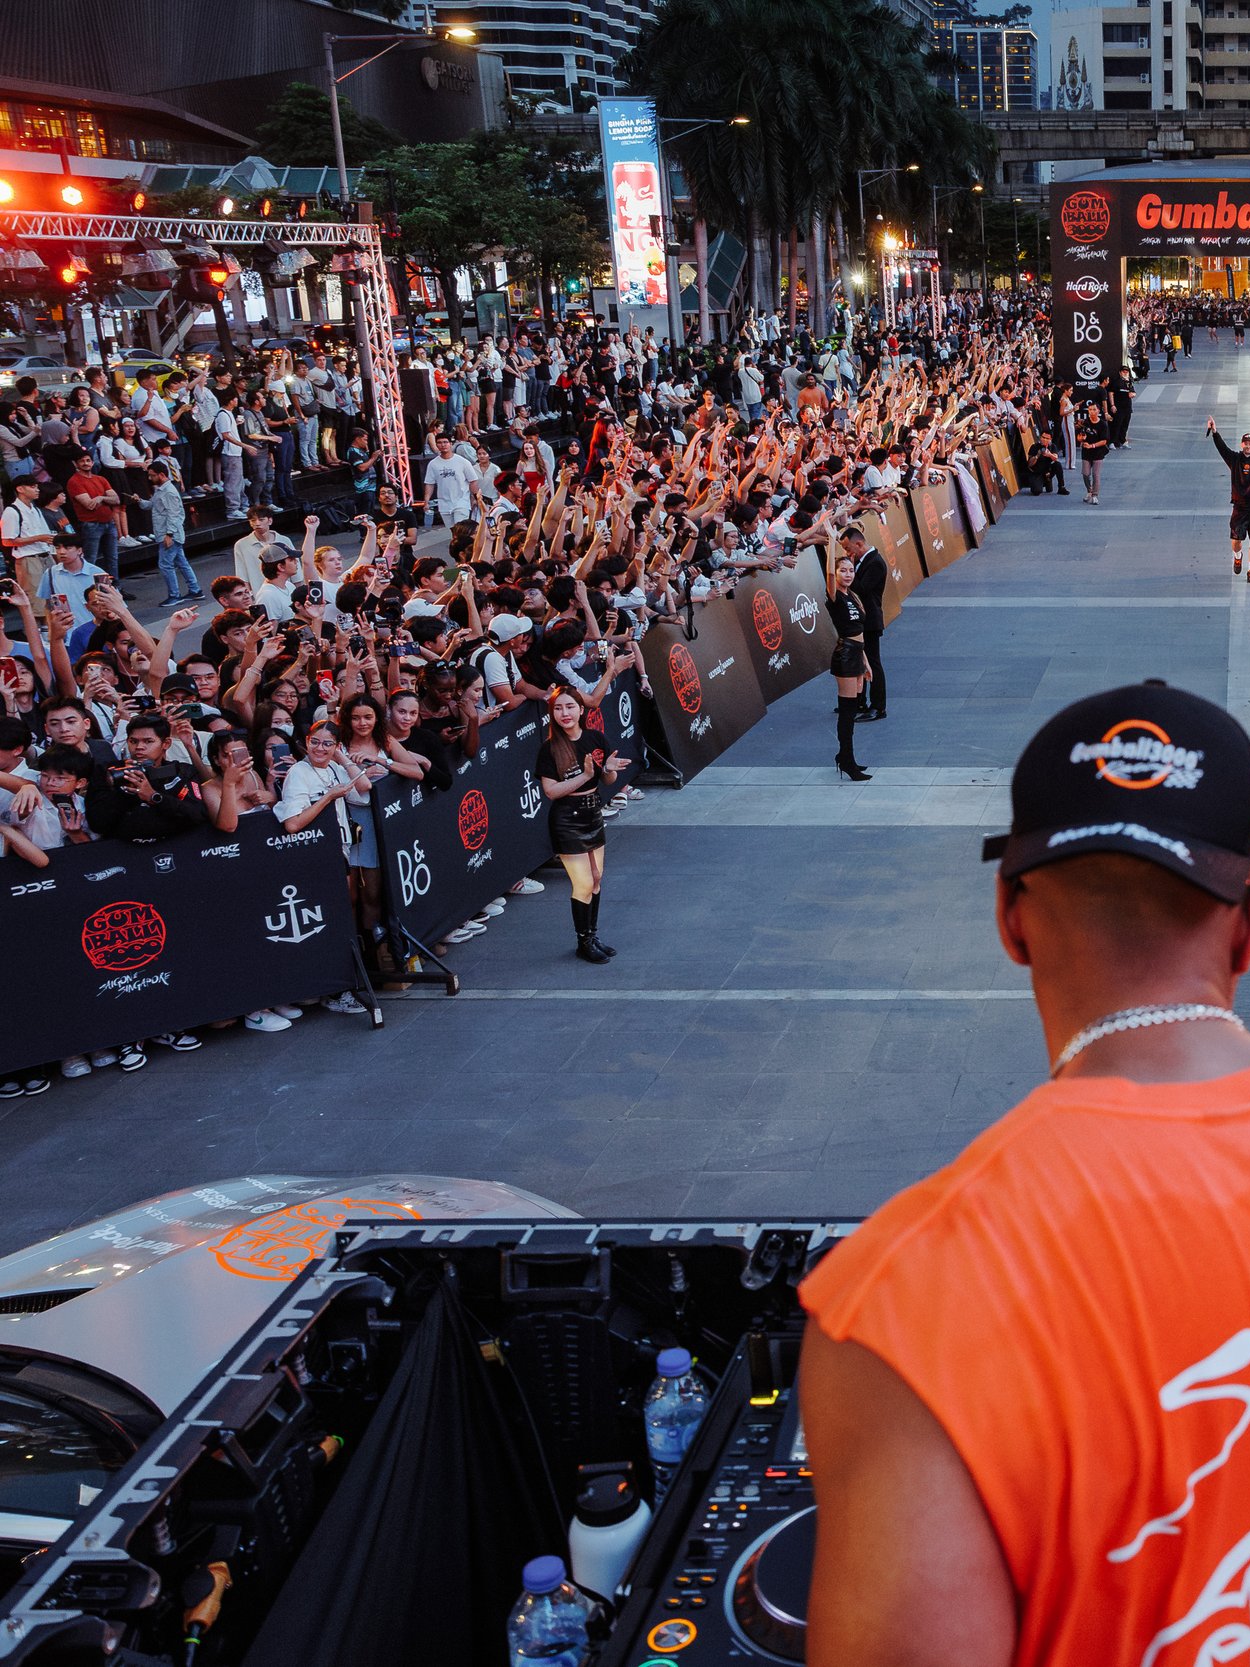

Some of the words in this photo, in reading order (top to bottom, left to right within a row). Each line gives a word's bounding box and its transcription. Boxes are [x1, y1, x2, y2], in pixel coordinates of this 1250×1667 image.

[1066, 281, 1088, 291] Hard
[1088, 281, 1109, 293] Rock
[266, 829, 325, 847] CAMBODIA
[275, 838, 318, 851] WATER
[86, 905, 157, 933] GUM
[85, 920, 163, 950] BALL
